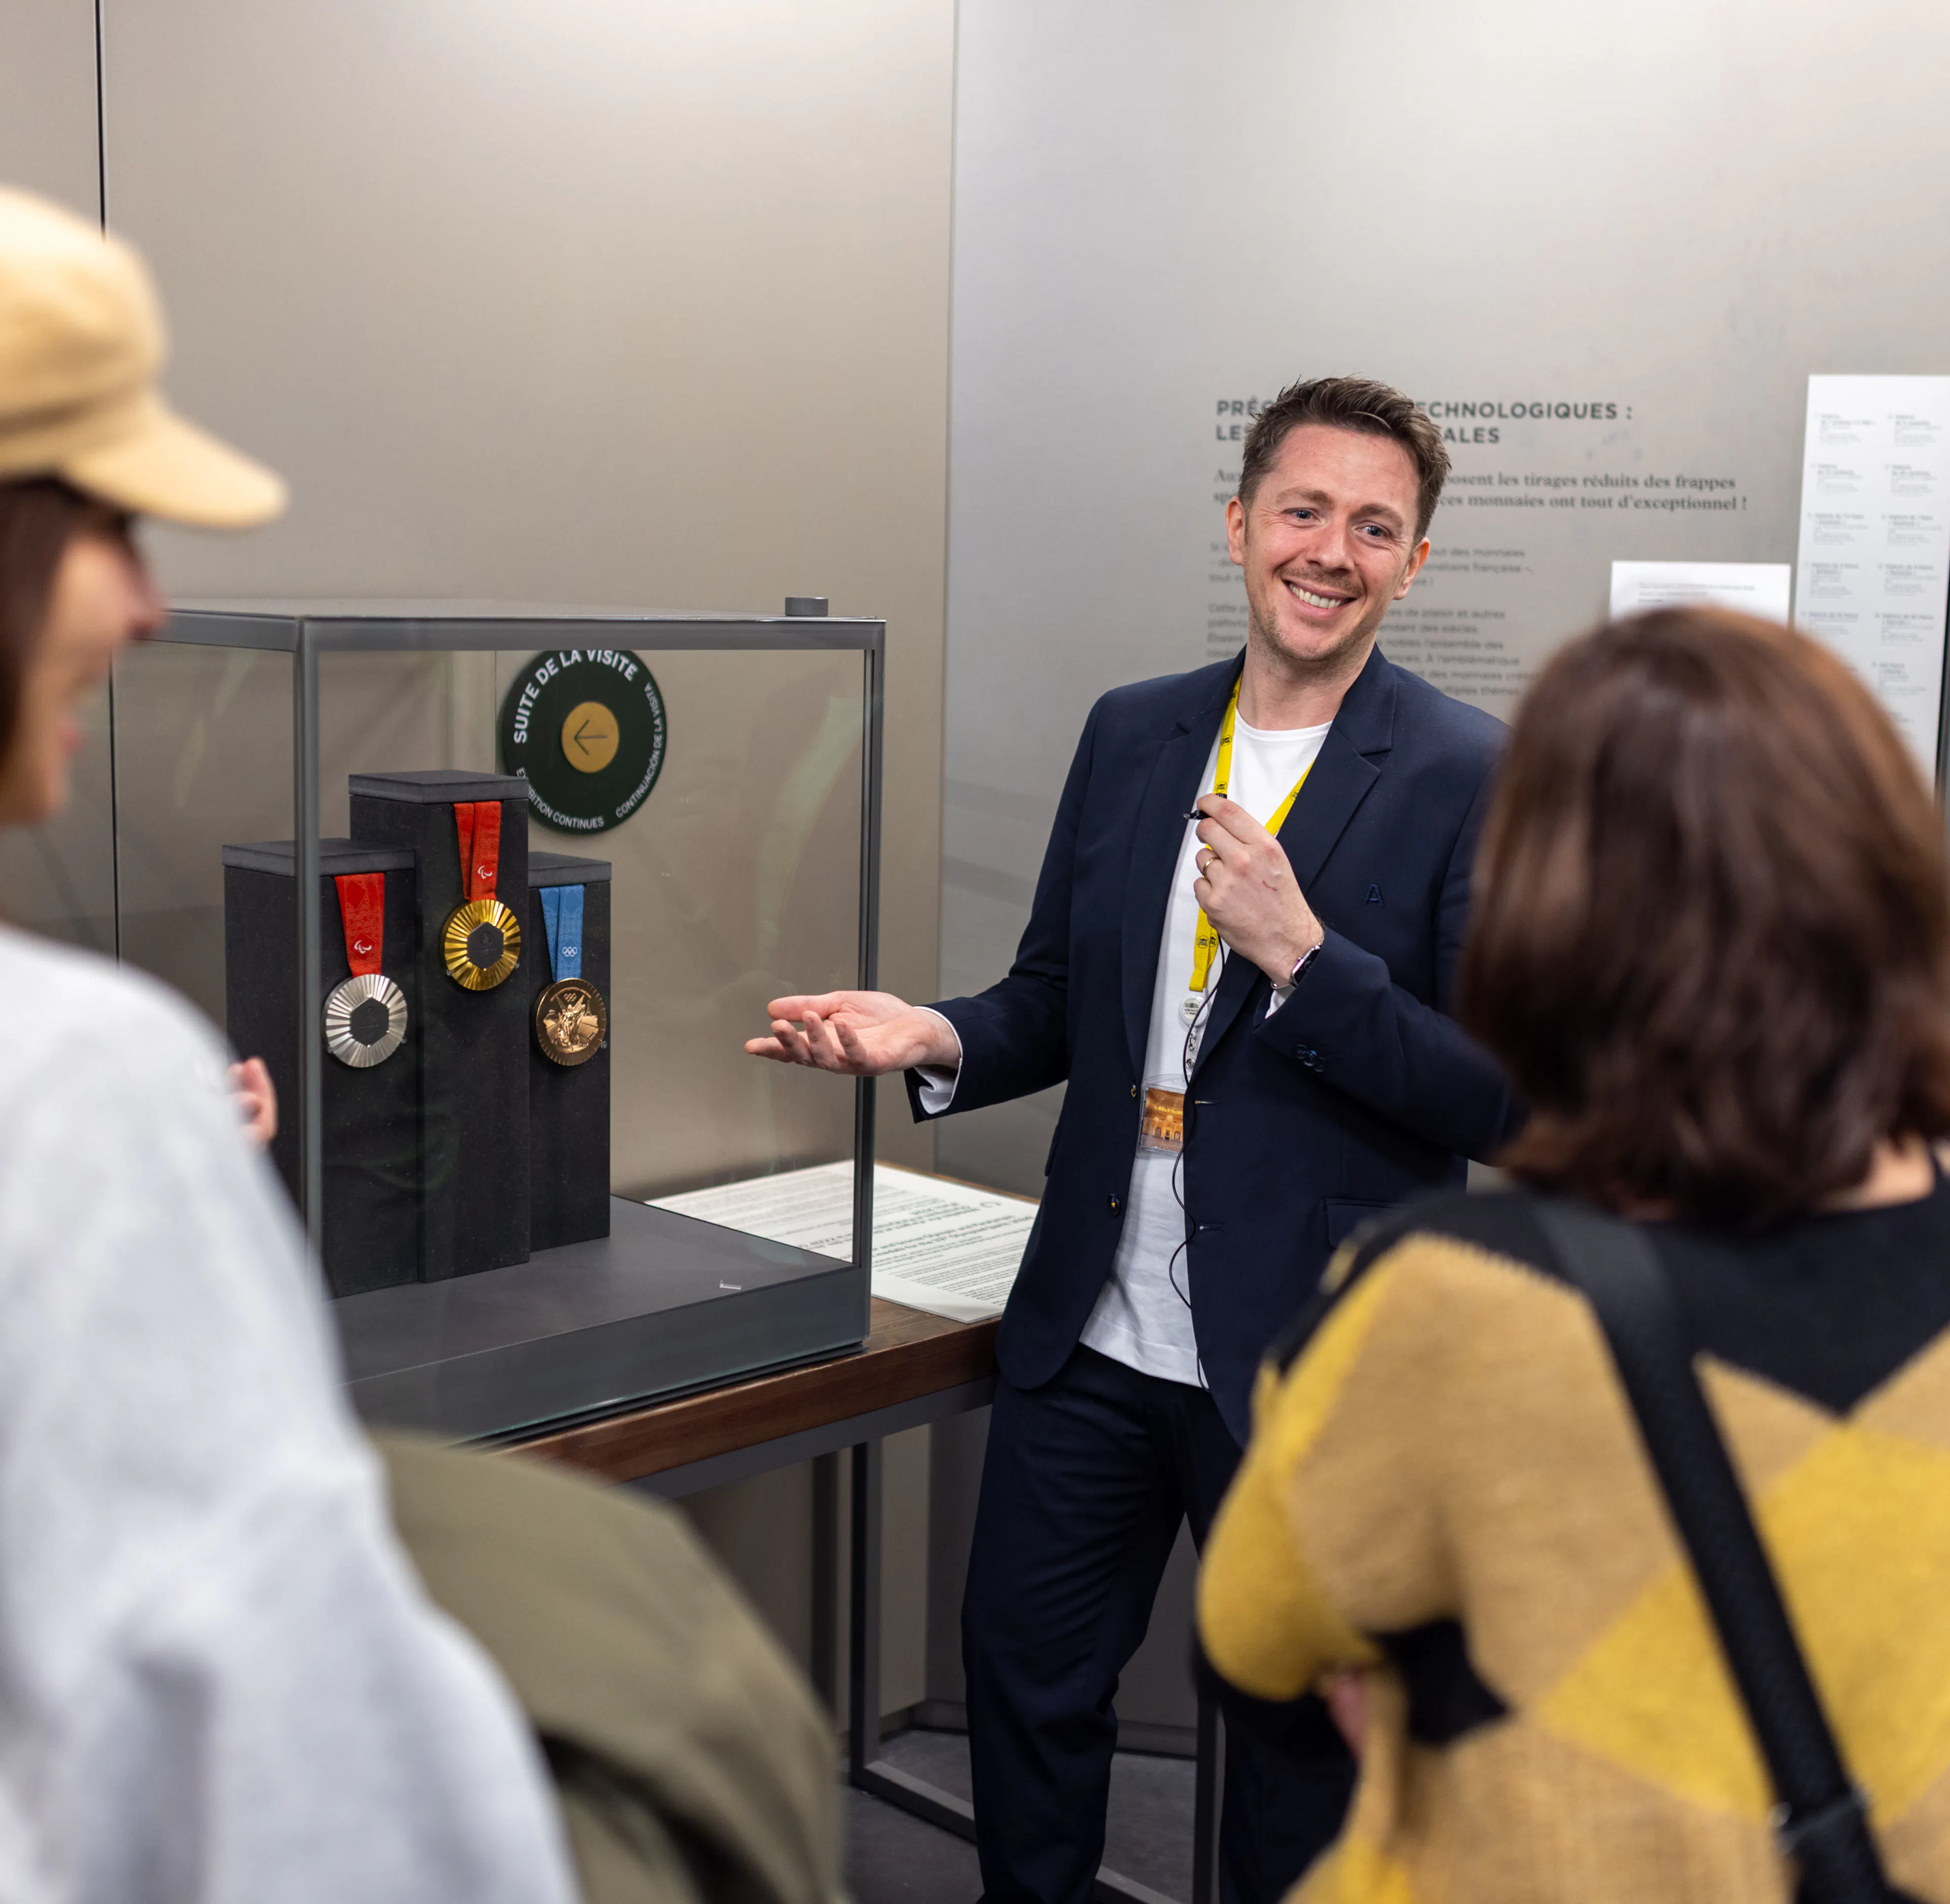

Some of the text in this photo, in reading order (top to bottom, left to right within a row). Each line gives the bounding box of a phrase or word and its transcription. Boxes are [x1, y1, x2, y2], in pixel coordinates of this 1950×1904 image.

[1416, 401, 1617, 419] CHNOLOGIQUES
[1443, 427, 1500, 443] ALES
[1498, 471, 1519, 487] les
[1524, 472, 1578, 491] tirages
[1582, 473, 1639, 488] réduits
[1643, 473, 1670, 488] des
[1676, 473, 1736, 492] frappes
[1468, 494, 1545, 507] monnaies
[1549, 496, 1576, 508] ont
[1580, 496, 1613, 508] tout
[513, 650, 639, 744] SUITE DE LA VISITE
[615, 682, 662, 818] CONTINUACIÓN DE LA VISITA
[552, 812, 604, 829] CONTINUES
[1362, 884, 1385, 908] A
